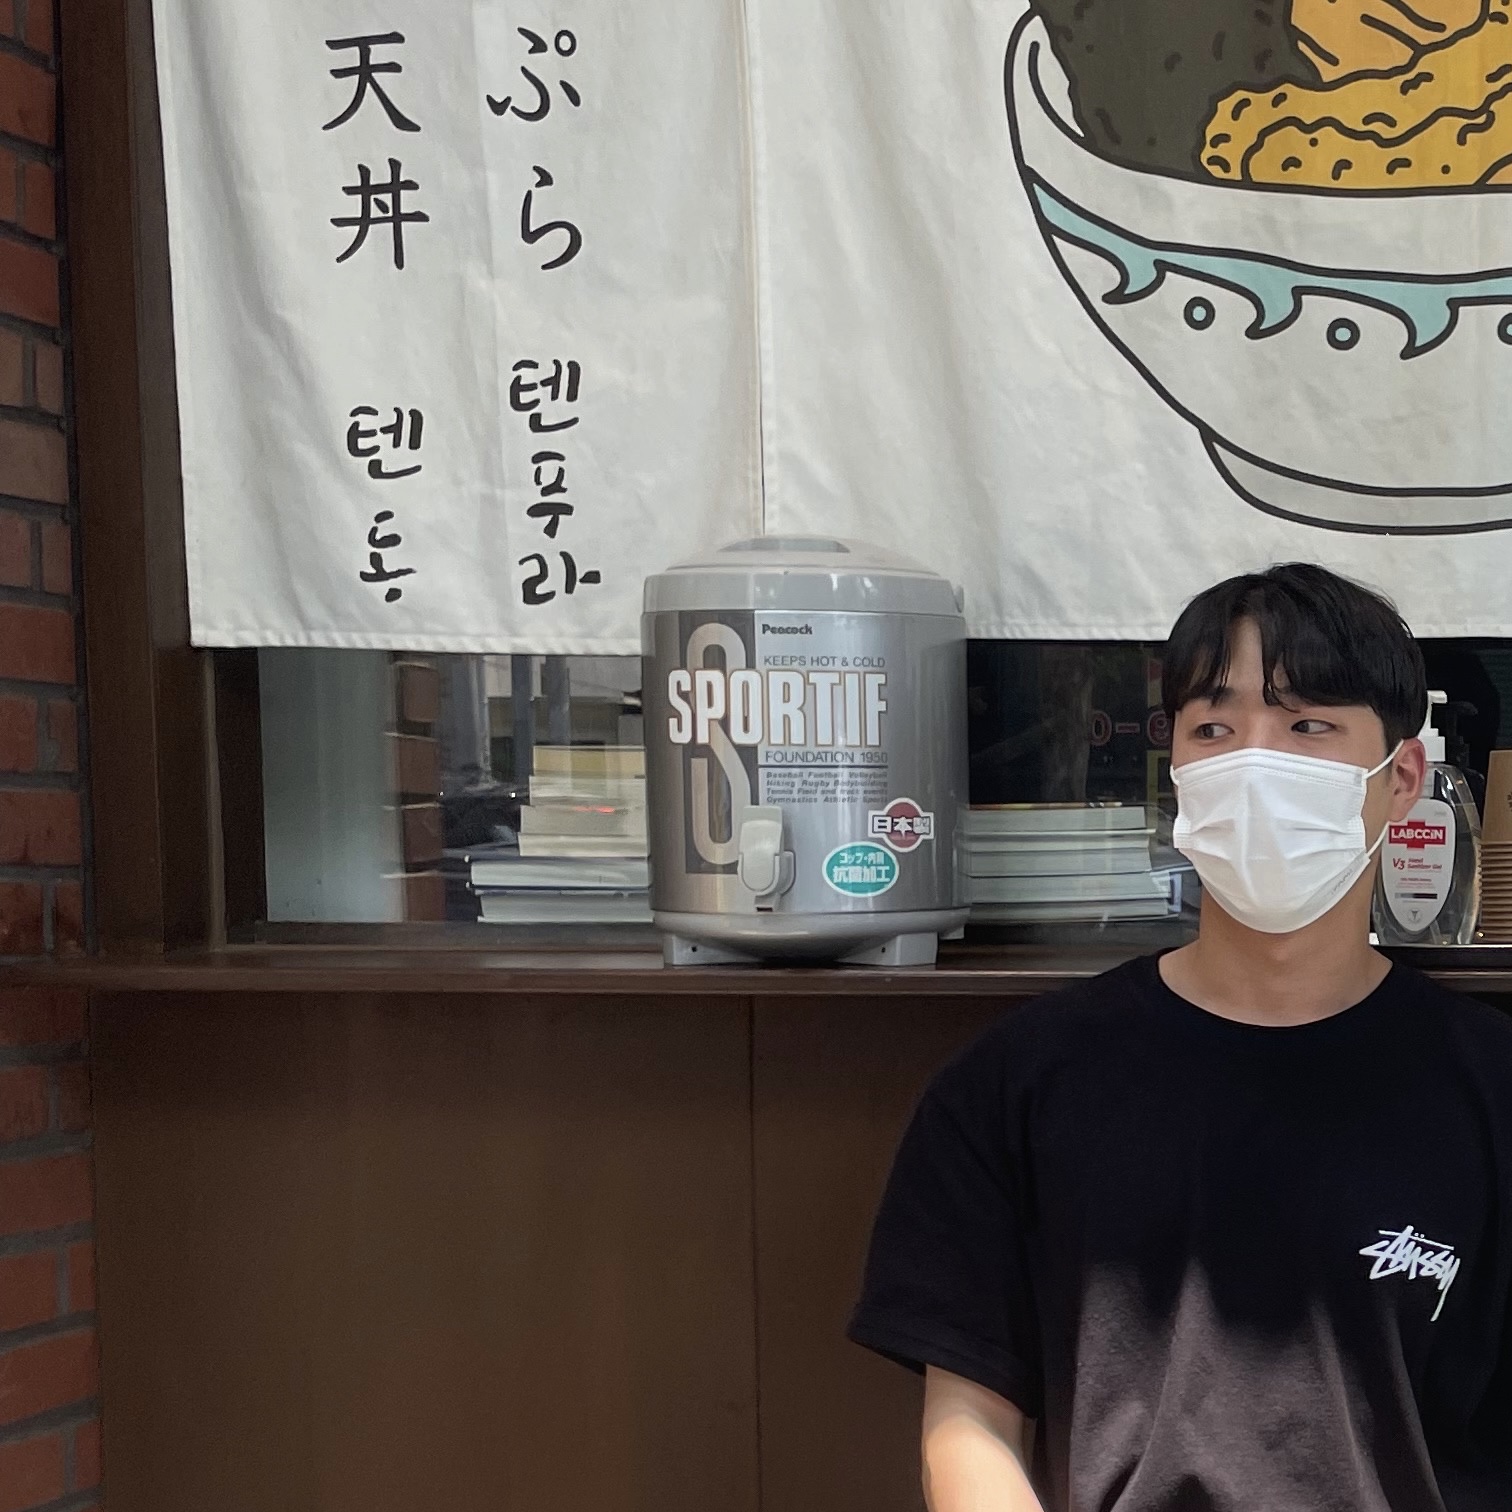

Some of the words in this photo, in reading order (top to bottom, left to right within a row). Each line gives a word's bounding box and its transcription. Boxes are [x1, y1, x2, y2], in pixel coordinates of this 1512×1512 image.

[322, 30, 430, 270] 天丼
[485, 26, 583, 271] ぷら
[346, 406, 424, 603] 텐동
[509, 358, 601, 605] 텐푸라
[762, 624, 813, 635] Peacock
[764, 656, 806, 666] KEEPS
[810, 656, 838, 667] HOT
[841, 657, 849, 667] &
[853, 656, 886, 668] COLD
[667, 669, 888, 747] SPORTIF
[765, 751, 855, 763] FOUNDATION
[860, 752, 888, 763] 1950
